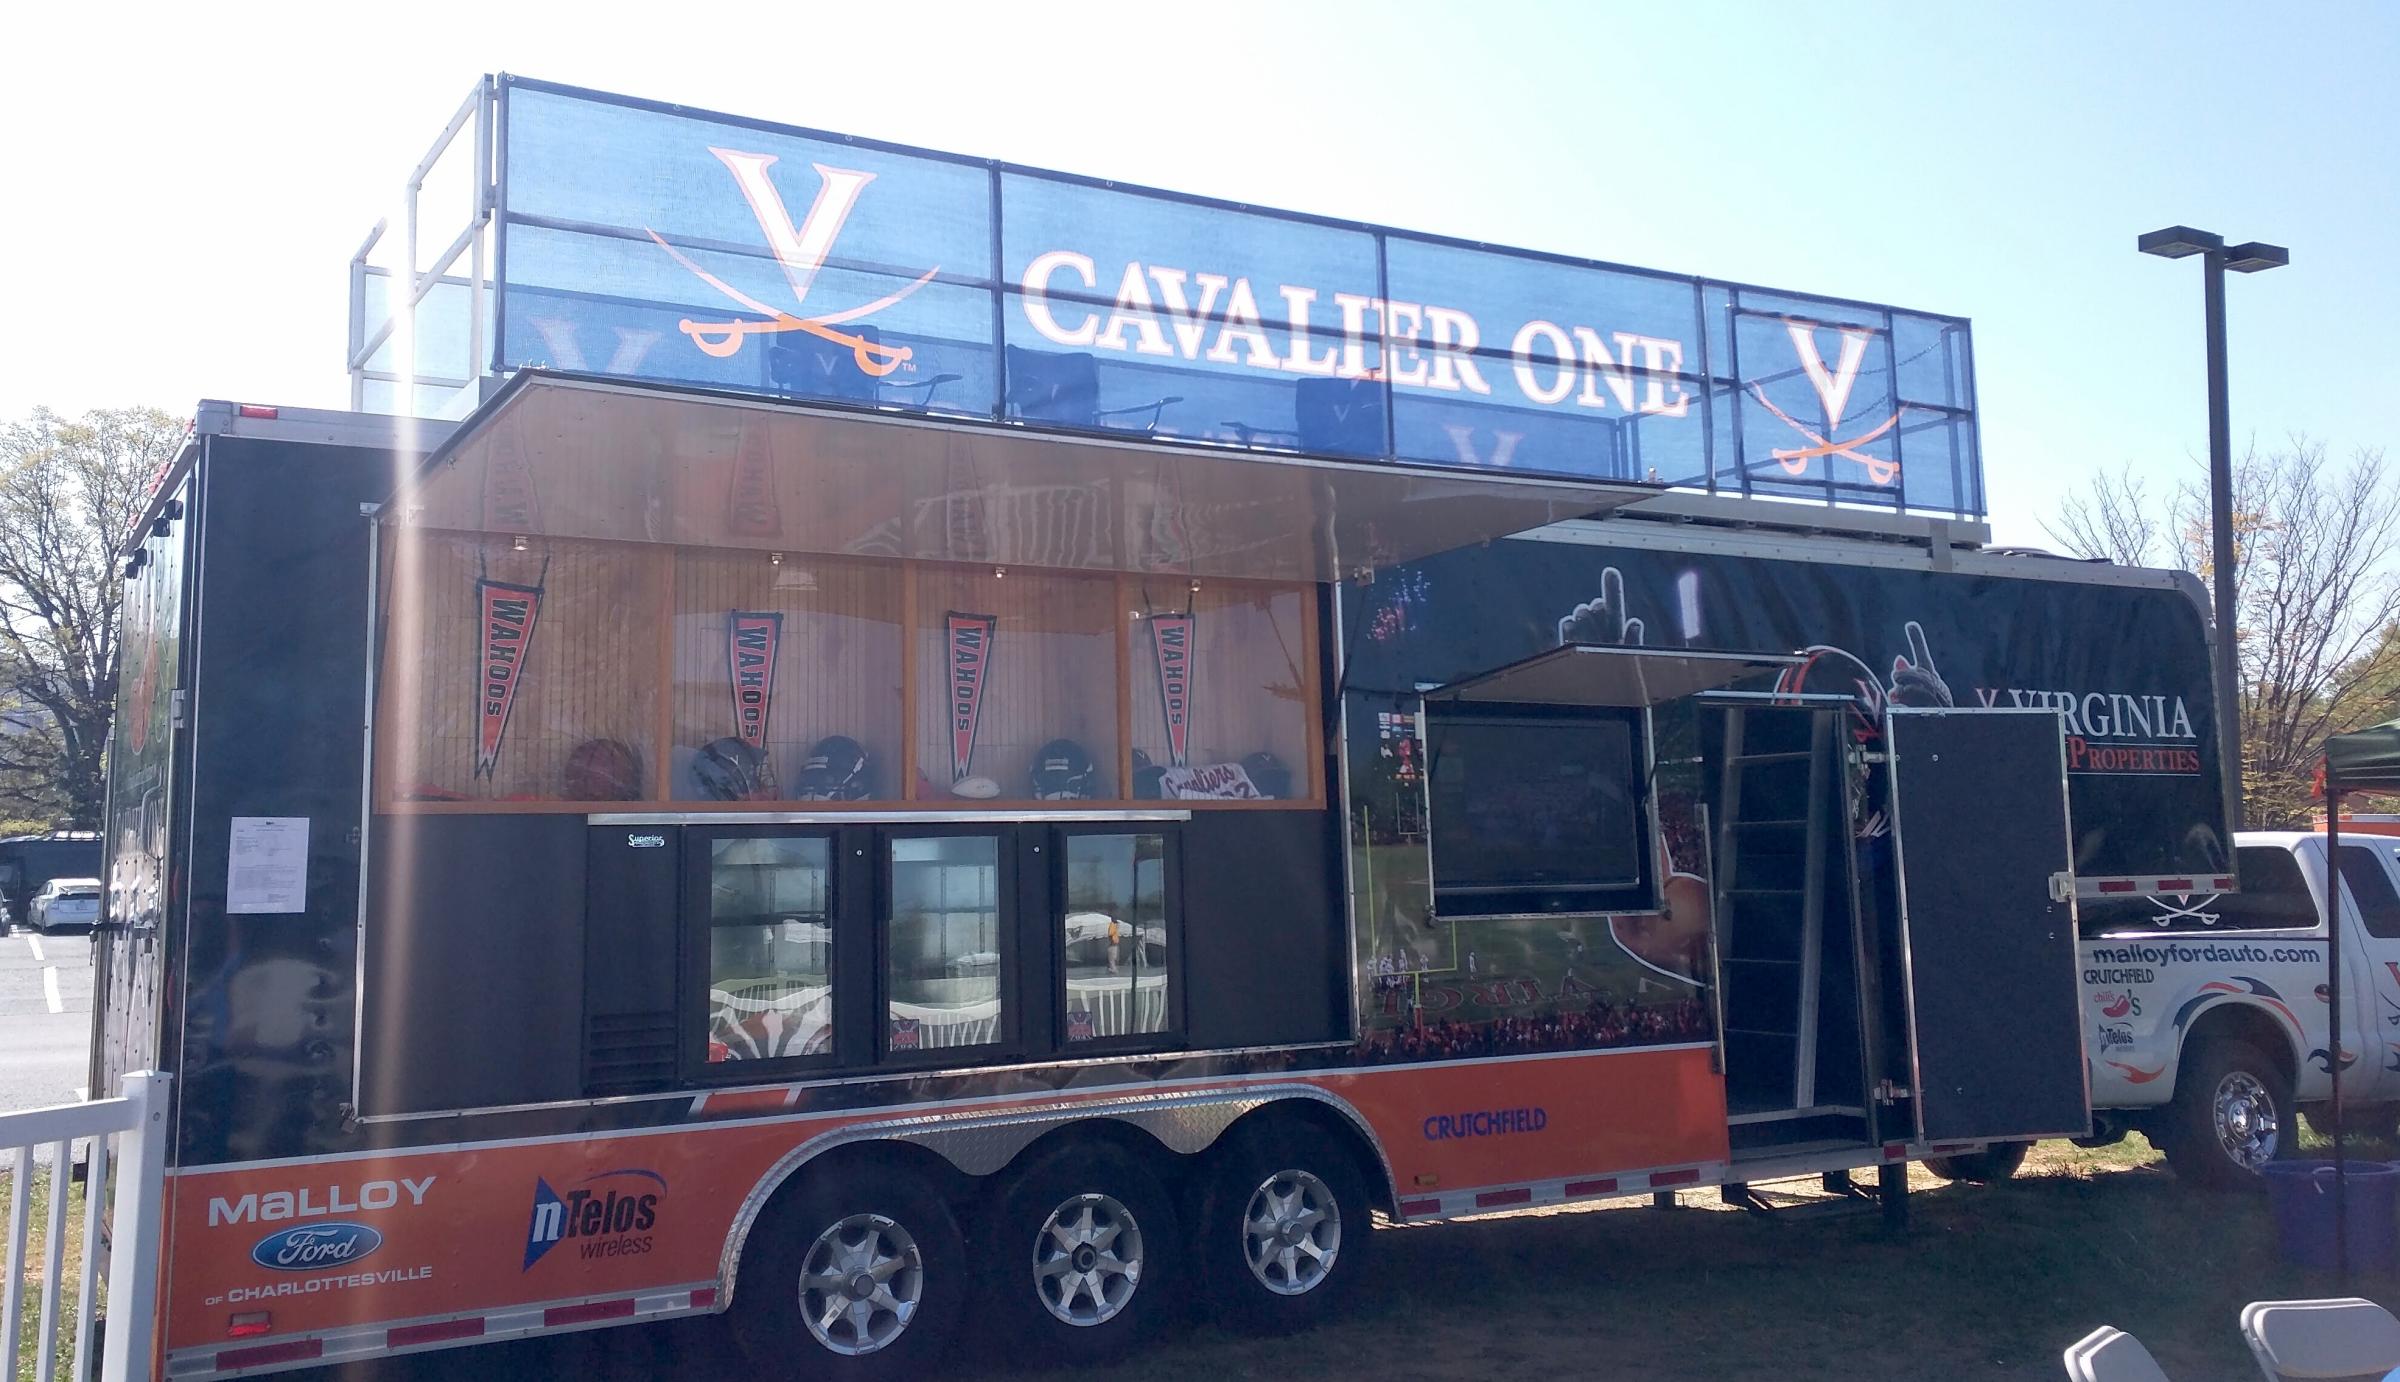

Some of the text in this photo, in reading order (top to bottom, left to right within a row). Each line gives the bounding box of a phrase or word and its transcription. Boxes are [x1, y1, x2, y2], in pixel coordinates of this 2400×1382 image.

[707, 146, 878, 303] V
[1020, 250, 1689, 417] CAVALIER ONE
[1783, 317, 1874, 431] V
[488, 599, 530, 717] WAHOOS
[735, 626, 769, 738] WAHOOS
[954, 627, 983, 731] WAHOOS
[1160, 626, 1185, 725] WAHOOS
[2066, 735, 2201, 771] PROPERTIES
[2083, 968, 2155, 985] CRUTCHFIELD
[2093, 944, 2320, 967] malloyfordauto.com
[1423, 1107, 1547, 1141] CRUTCHFIELD
[532, 1189, 657, 1243] nTelos
[277, 1229, 358, 1265] Ford
[580, 1235, 653, 1260] wireless
[205, 1266, 433, 1306] OF CHARLOTTESVILLE
